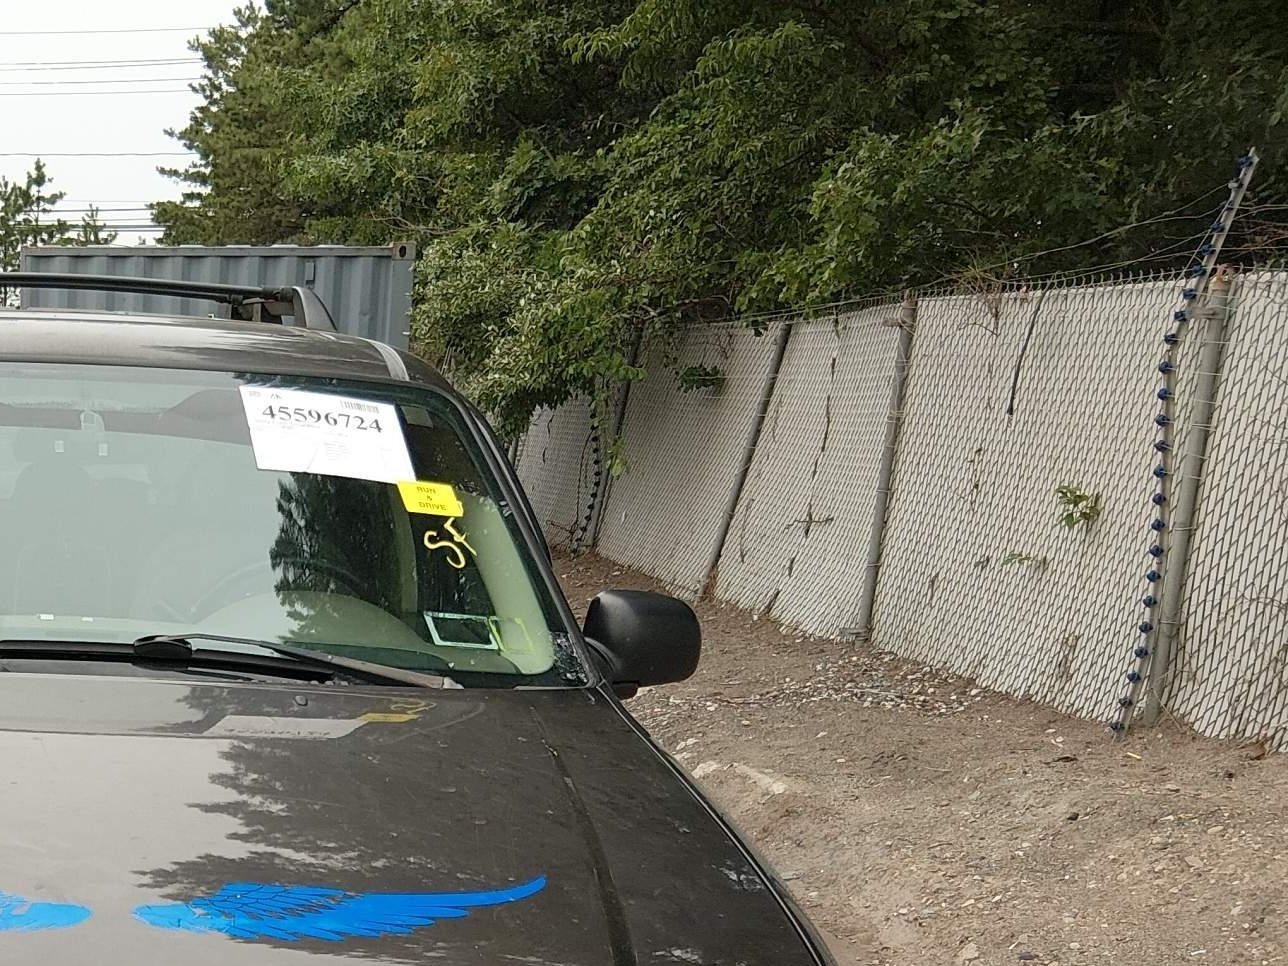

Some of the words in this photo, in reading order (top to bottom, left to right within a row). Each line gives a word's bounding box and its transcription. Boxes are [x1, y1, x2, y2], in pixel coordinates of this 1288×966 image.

[262, 404, 383, 433] 45596724
[416, 486, 437, 494] RUN
[418, 502, 447, 511] DRIVE
